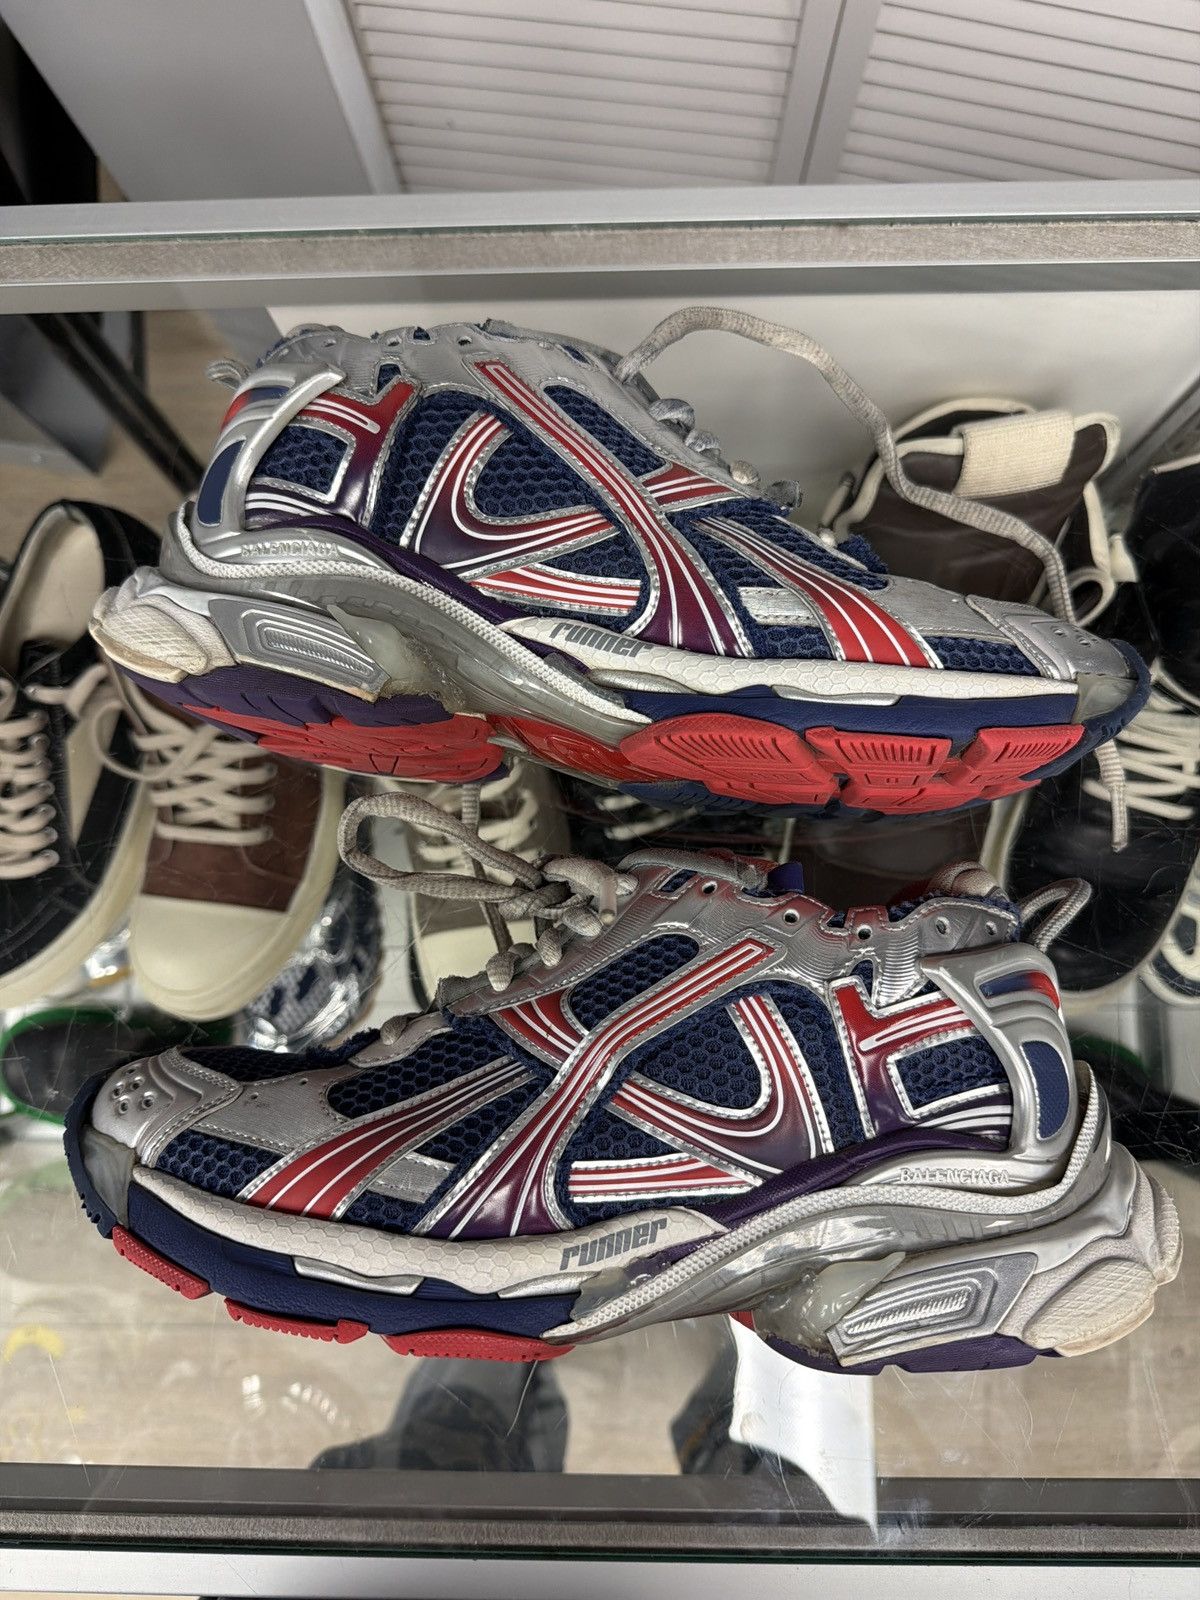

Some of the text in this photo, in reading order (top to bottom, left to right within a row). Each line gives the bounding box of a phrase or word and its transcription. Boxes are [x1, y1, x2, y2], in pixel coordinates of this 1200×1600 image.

[241, 541, 340, 557] BALENCIAGA
[549, 622, 655, 657] runner
[900, 1167, 1009, 1184] BALENCIAGA
[560, 1217, 667, 1271] runner
